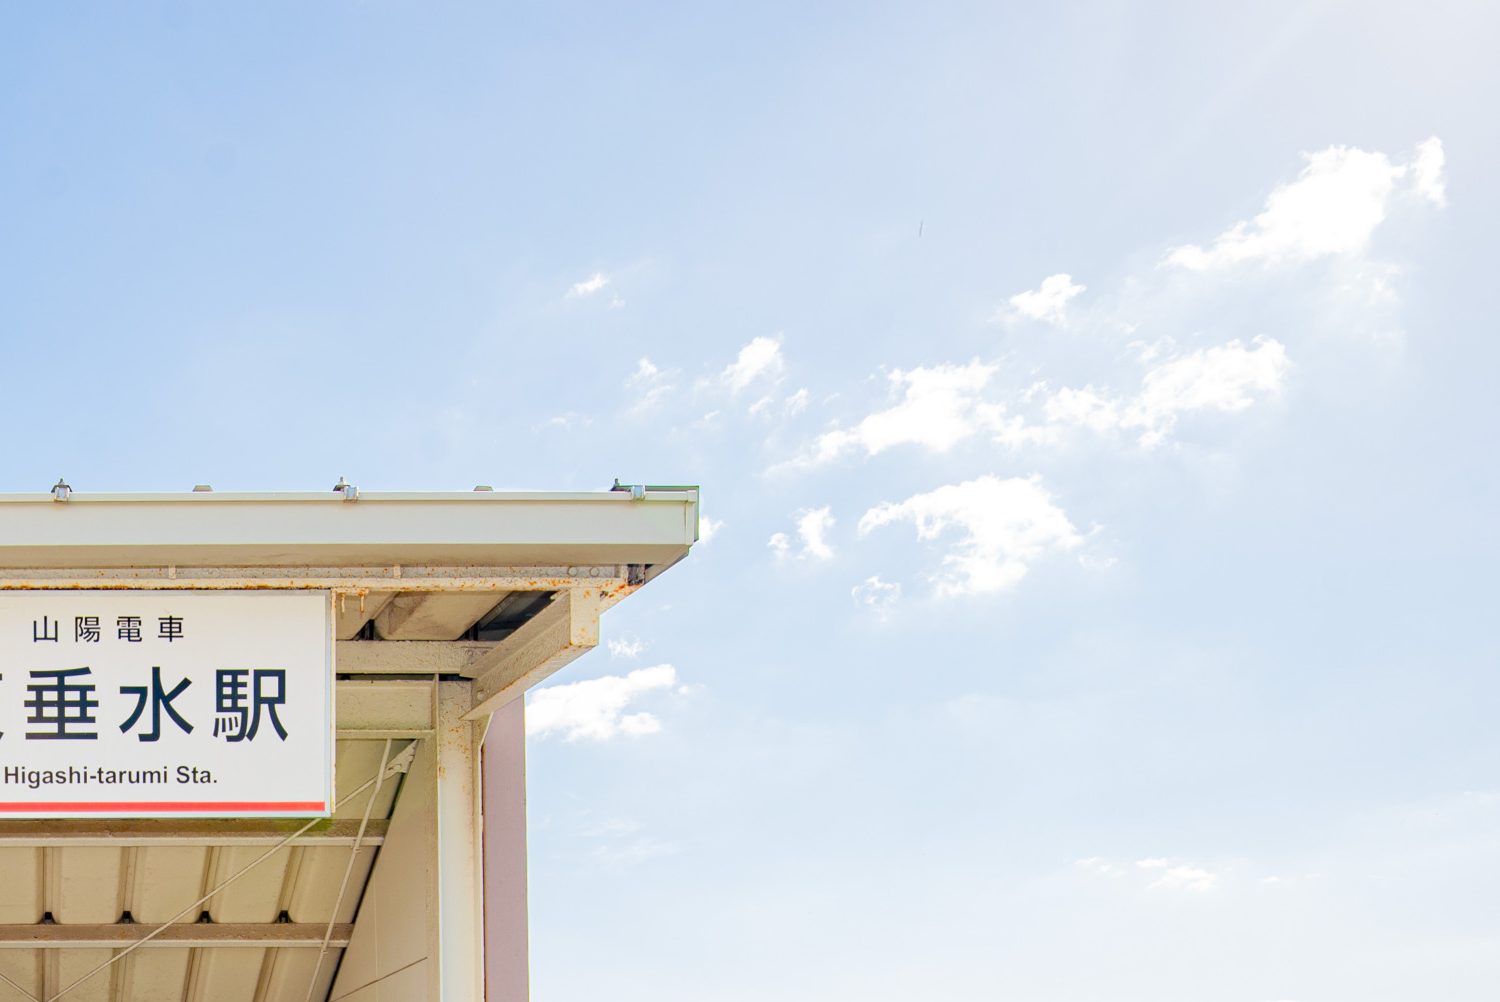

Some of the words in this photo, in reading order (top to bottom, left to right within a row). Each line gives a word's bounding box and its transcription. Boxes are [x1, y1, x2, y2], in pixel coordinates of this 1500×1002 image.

[32, 615, 185, 643] 山陽電車
[3, 764, 169, 789] Higashi-tarumi
[176, 765, 219, 785] Sta.
